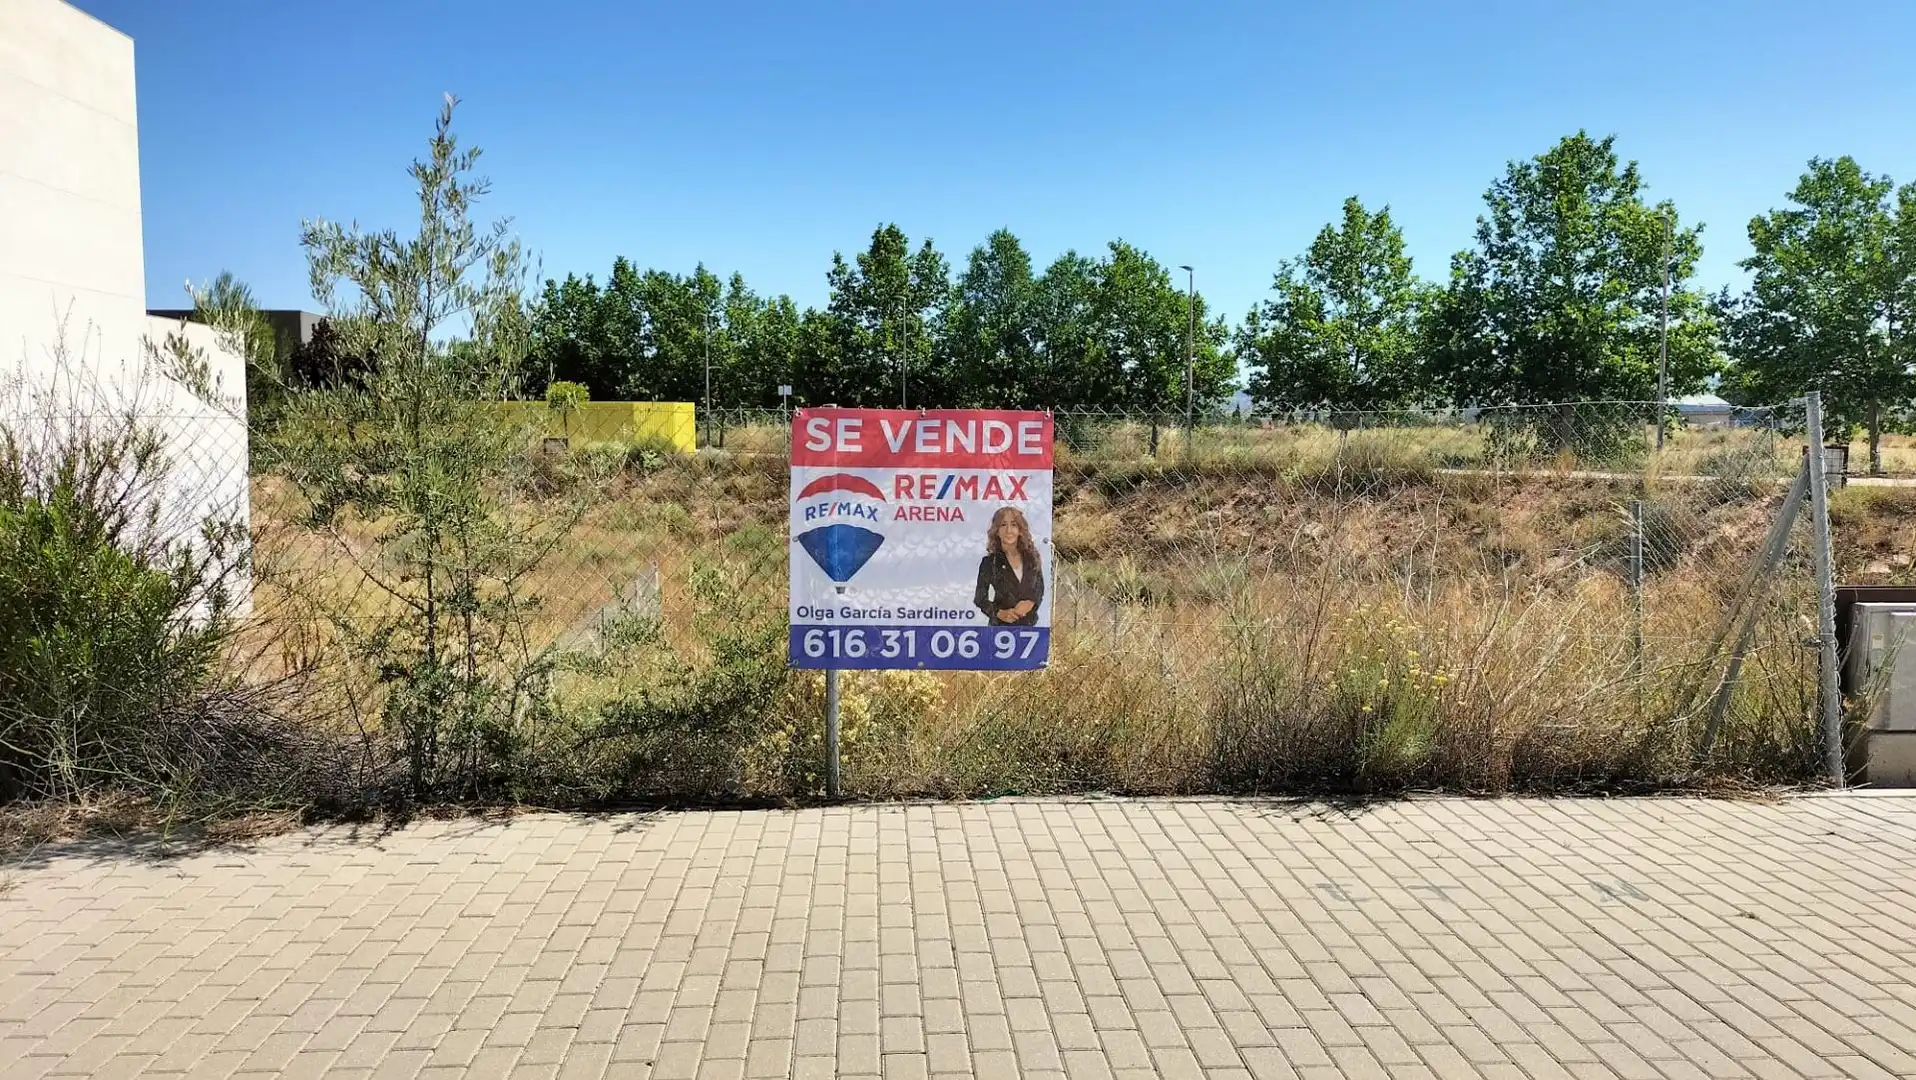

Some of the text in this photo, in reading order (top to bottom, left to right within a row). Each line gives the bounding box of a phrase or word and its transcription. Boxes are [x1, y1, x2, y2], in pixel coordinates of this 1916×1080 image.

[806, 417, 1043, 454] SE VENDE
[895, 474, 1029, 500] RE/MAX
[805, 502, 878, 522] RE/MAX
[894, 507, 964, 521] ARENA
[797, 606, 975, 620] Olga García Sardinero
[804, 630, 1039, 658] 616 31 06 97
